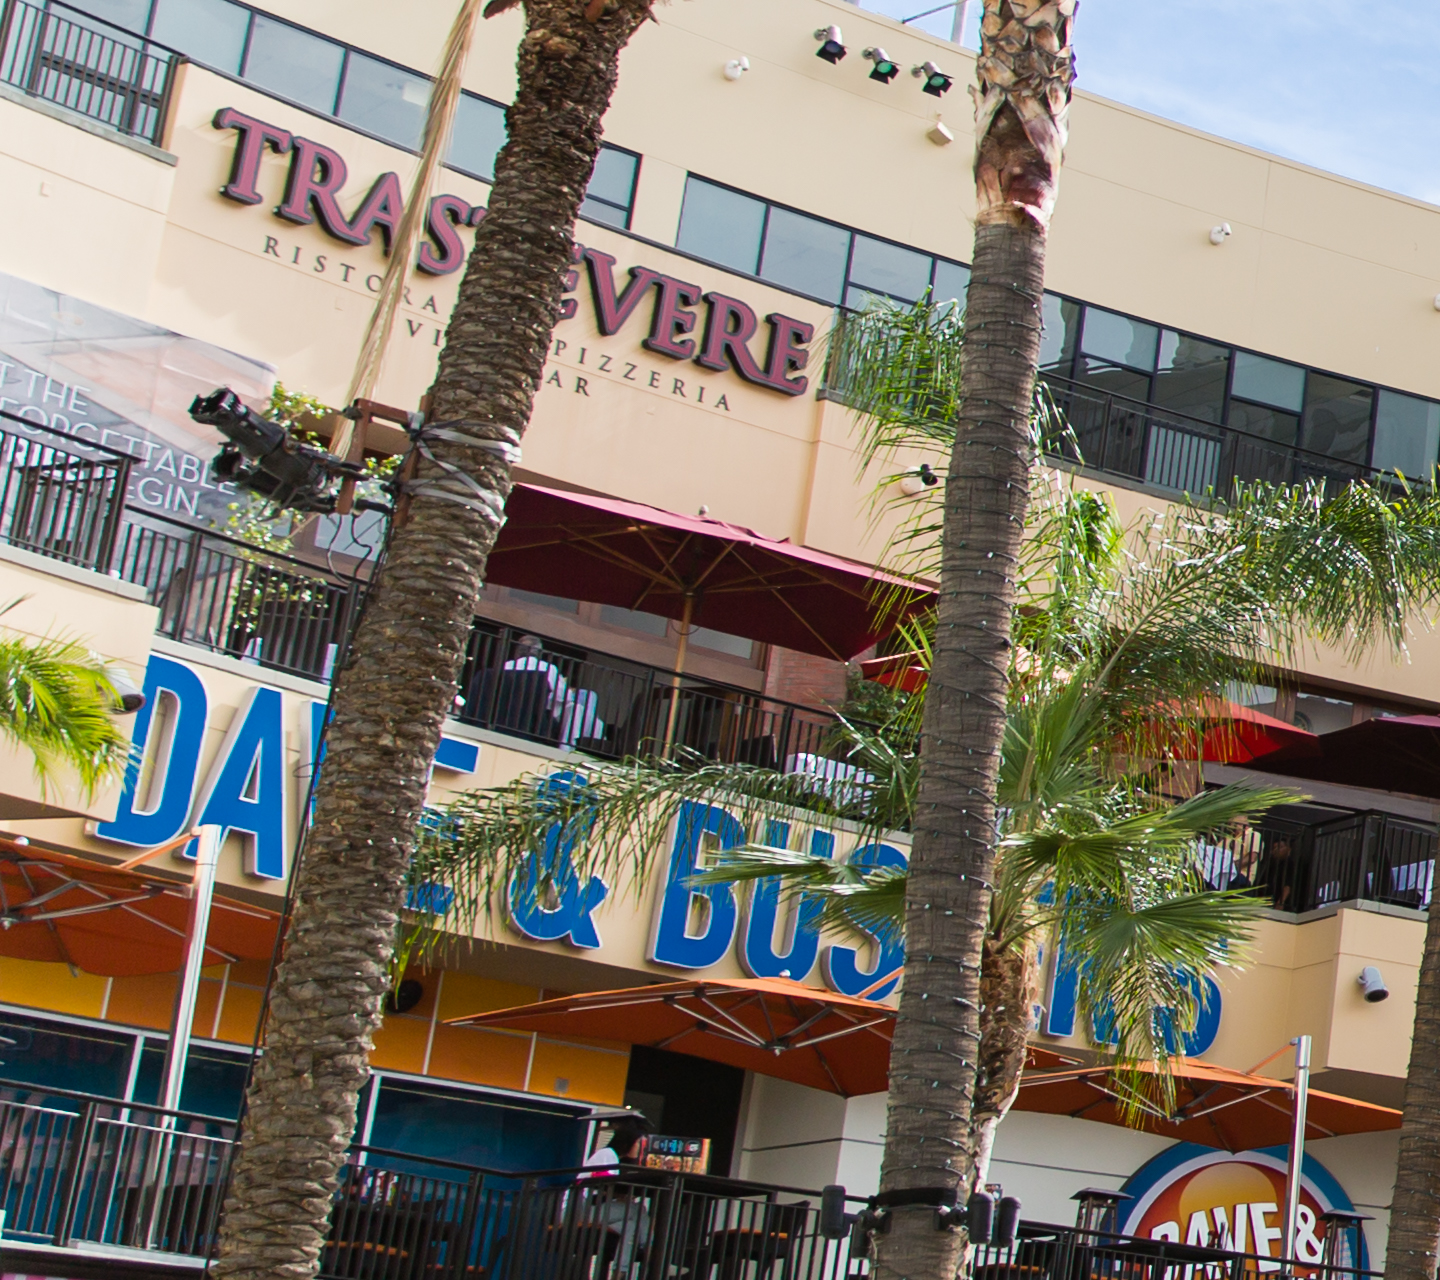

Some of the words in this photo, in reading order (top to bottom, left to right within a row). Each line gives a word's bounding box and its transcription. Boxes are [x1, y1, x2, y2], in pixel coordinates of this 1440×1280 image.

[212, 107, 816, 397] TRASVERE
[24, 369, 91, 417] THE
[545, 367, 593, 399] AR
[555, 337, 734, 414] PIZZERIA
[95, 654, 478, 917] DAE
[508, 770, 608, 950] &
